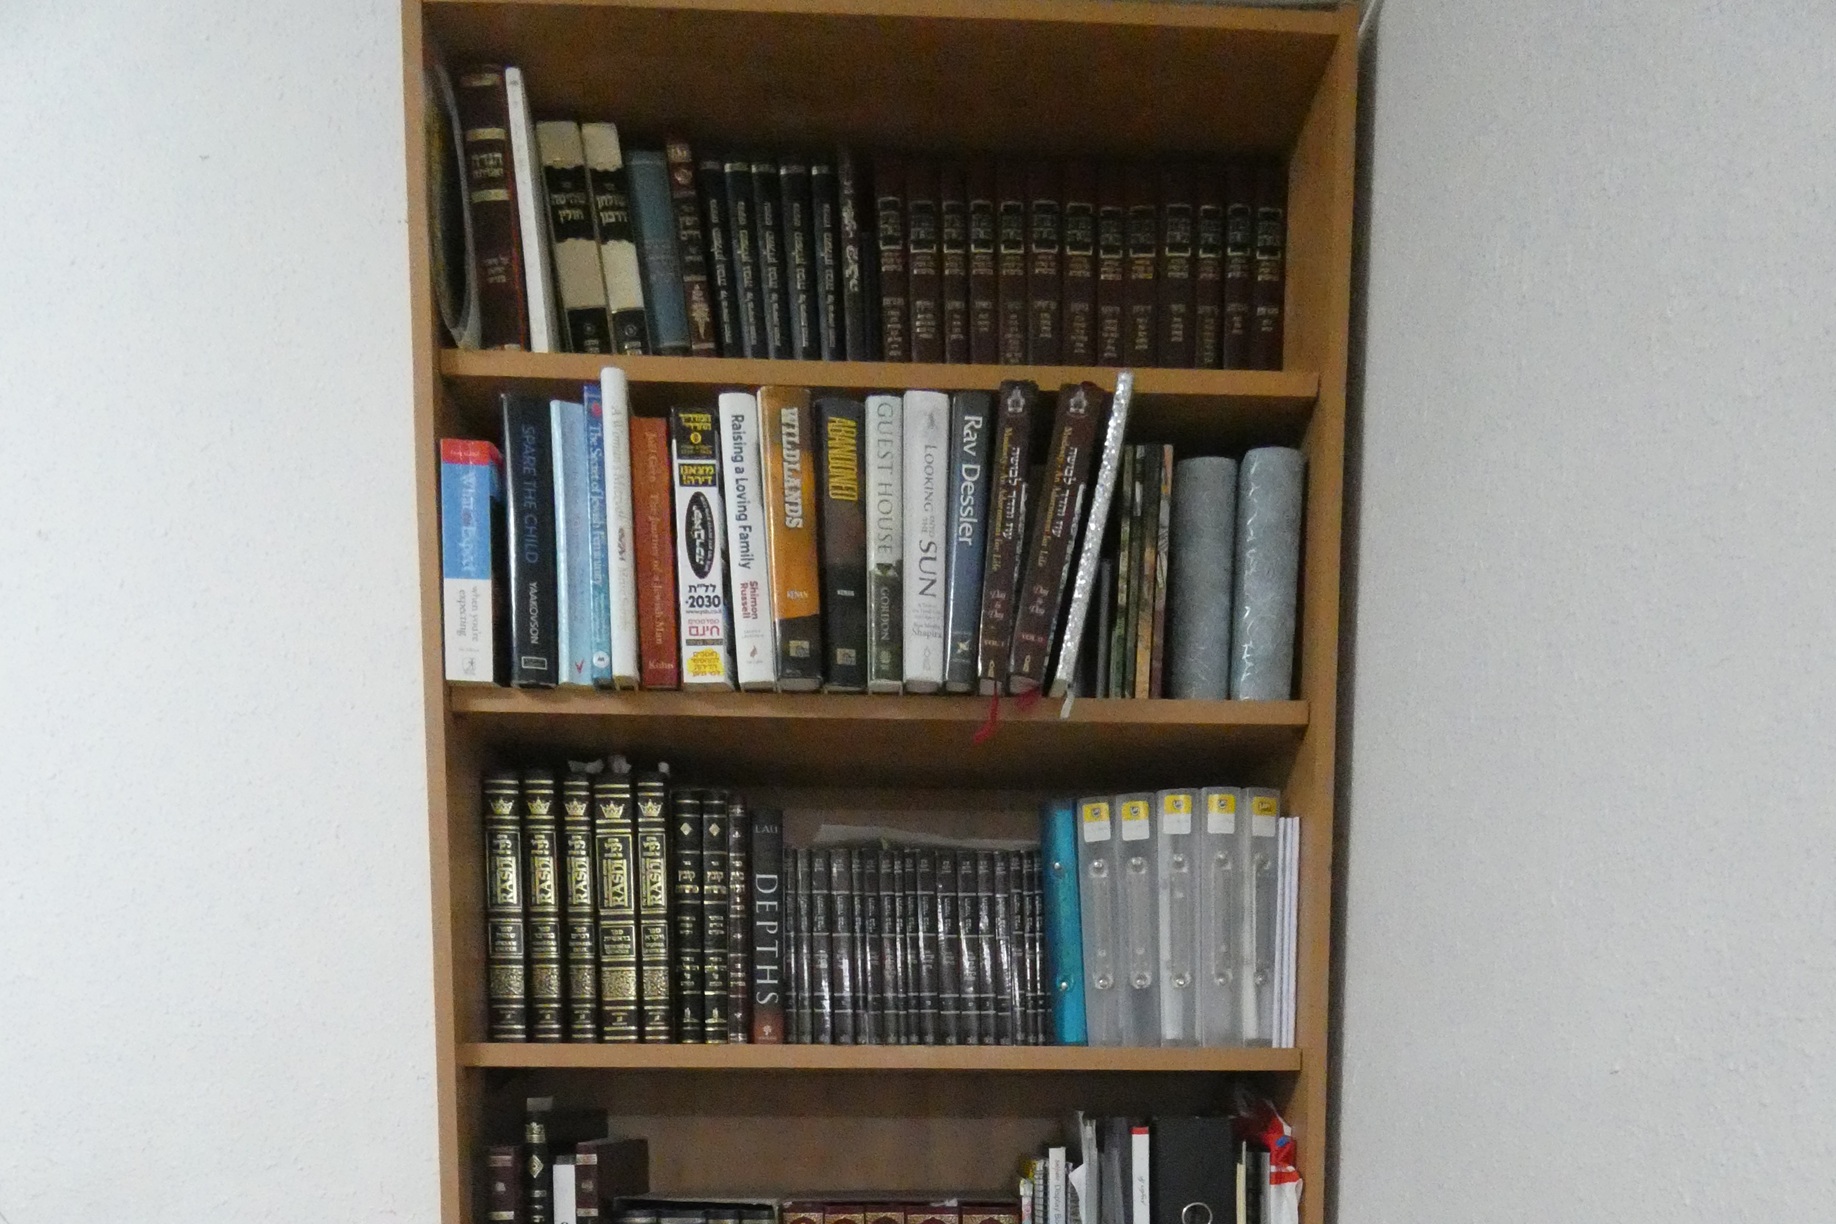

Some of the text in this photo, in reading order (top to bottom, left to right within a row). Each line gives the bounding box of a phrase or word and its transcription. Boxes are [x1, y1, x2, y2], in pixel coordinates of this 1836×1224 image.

[589, 425, 602, 444] The
[730, 414, 749, 463] Raising
[590, 446, 603, 477] Secret
[591, 478, 603, 493] of
[781, 407, 804, 529] WILDLANDS
[877, 402, 894, 555] GUEST HOUSE
[923, 444, 938, 512] LOOKING
[958, 415, 983, 547] Rav Dessler
[521, 424, 538, 564] SPARE THE CHILD
[733, 477, 751, 522] Loving
[460, 525, 478, 573] Expect
[736, 524, 753, 570] Family
[918, 539, 937, 598] SUN
[455, 589, 468, 638] expecting
[471, 586, 480, 611] when
[528, 580, 540, 645] YAAKOVSON
[740, 582, 751, 620] Russell
[749, 580, 759, 620] Shimon
[880, 587, 890, 641] GORDON
[753, 823, 778, 834] LAU
[756, 873, 779, 1005] DEPTHS
[1053, 1184, 1062, 1212] Display
